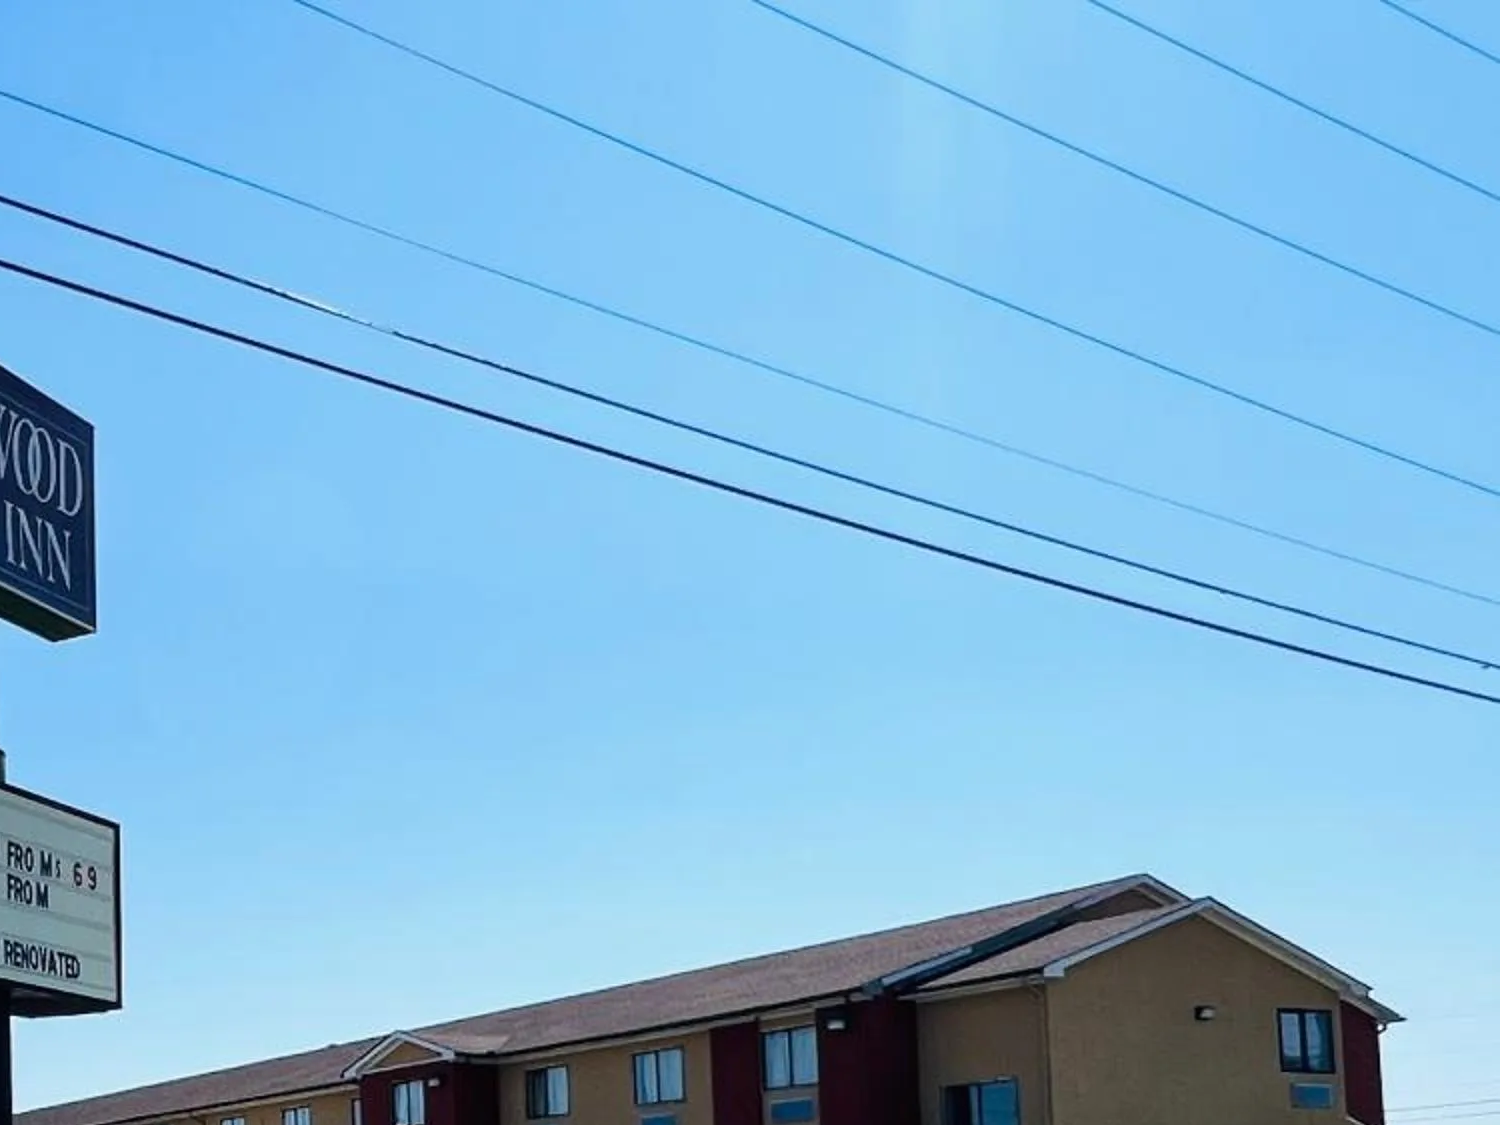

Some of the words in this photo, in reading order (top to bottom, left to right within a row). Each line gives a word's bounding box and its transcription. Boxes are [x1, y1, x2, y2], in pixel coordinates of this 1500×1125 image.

[4, 500, 70, 589] INN
[8, 874, 48, 907] FROM
[5, 941, 79, 977] RENOVATED
